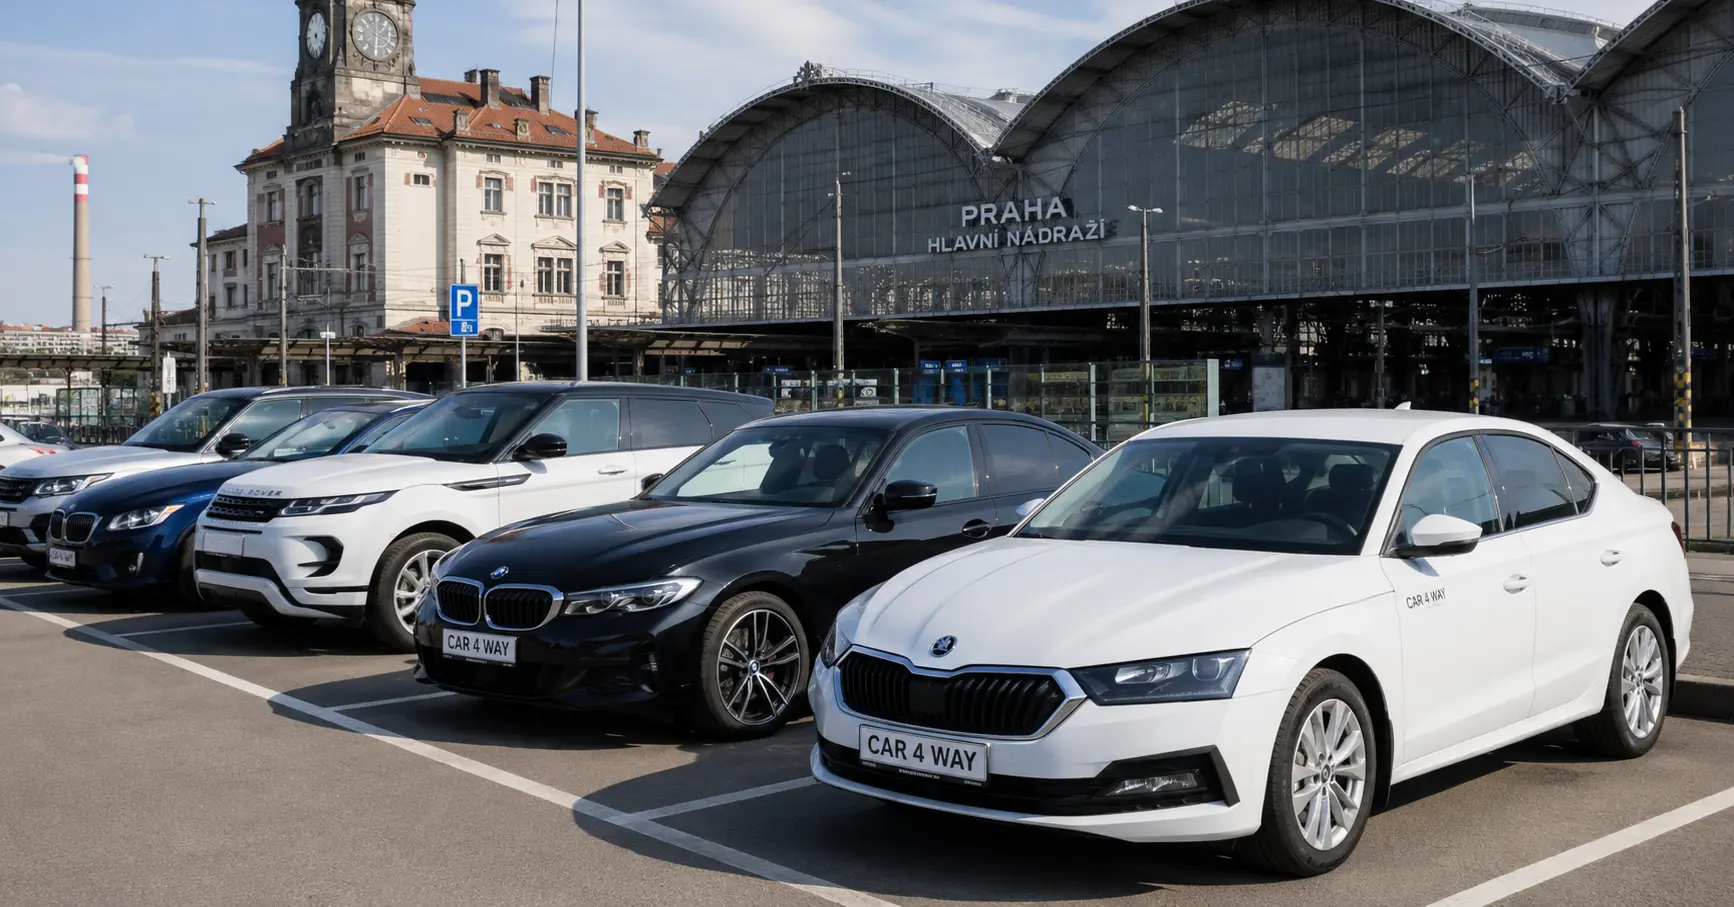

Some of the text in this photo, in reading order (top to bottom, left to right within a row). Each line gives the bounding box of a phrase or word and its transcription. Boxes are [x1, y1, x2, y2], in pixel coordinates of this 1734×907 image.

[961, 196, 1068, 227] PRAHA
[927, 218, 1105, 253] HLAVNÍ NÁDRAŽÍ
[457, 289, 472, 317] P
[1406, 594, 1424, 609] CAR
[1430, 587, 1446, 602] WAY
[447, 634, 509, 656] CAR 4 WAY
[868, 735, 977, 771] CAR 4 WAY
